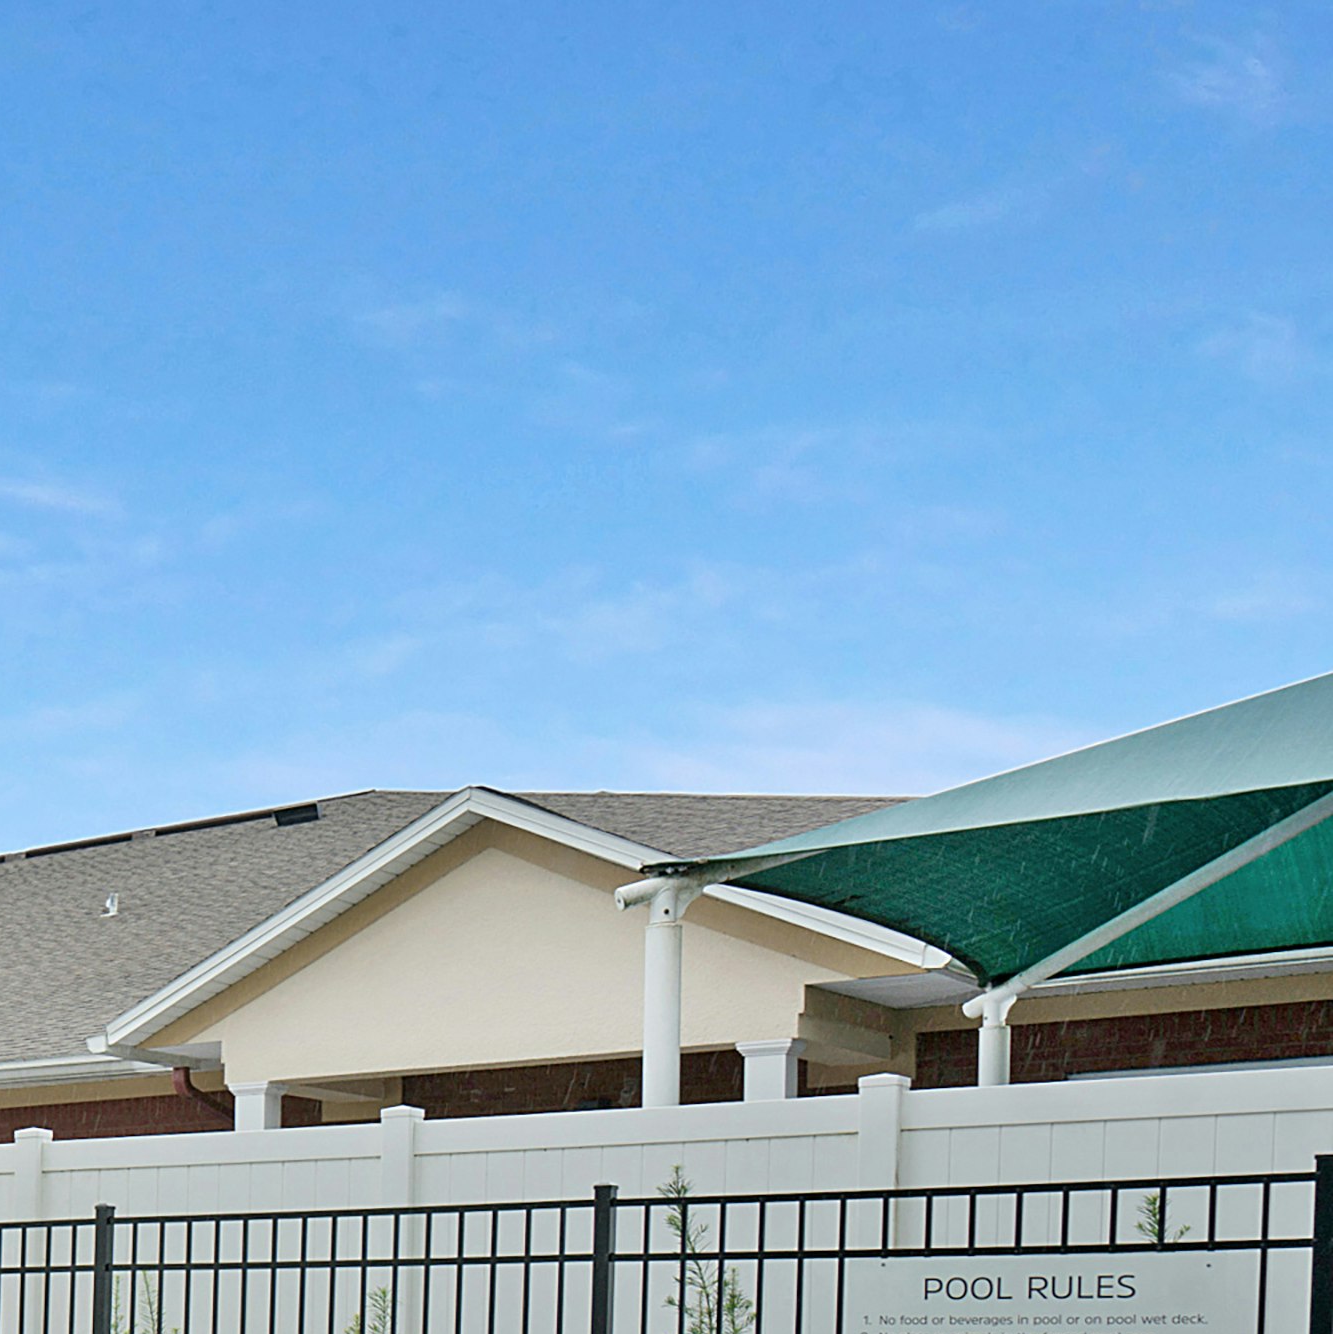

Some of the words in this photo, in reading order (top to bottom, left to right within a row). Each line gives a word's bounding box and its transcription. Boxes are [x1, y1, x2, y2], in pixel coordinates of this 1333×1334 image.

[924, 1277, 1013, 1300] POOL
[1028, 1275, 1136, 1299] RULES
[863, 1316, 872, 1325] 1.
[879, 1316, 896, 1325] No
[900, 1315, 927, 1325] food
[932, 1316, 944, 1325] or
[949, 1315, 1013, 1327] beverages
[1018, 1315, 1028, 1325] in
[1034, 1315, 1061, 1326] pool
[1066, 1316, 1080, 1325] or
[1084, 1316, 1101, 1325] on
[1107, 1315, 1136, 1326] pool
[1141, 1315, 1166, 1325] wet
[1171, 1314, 1208, 1325] deck.
